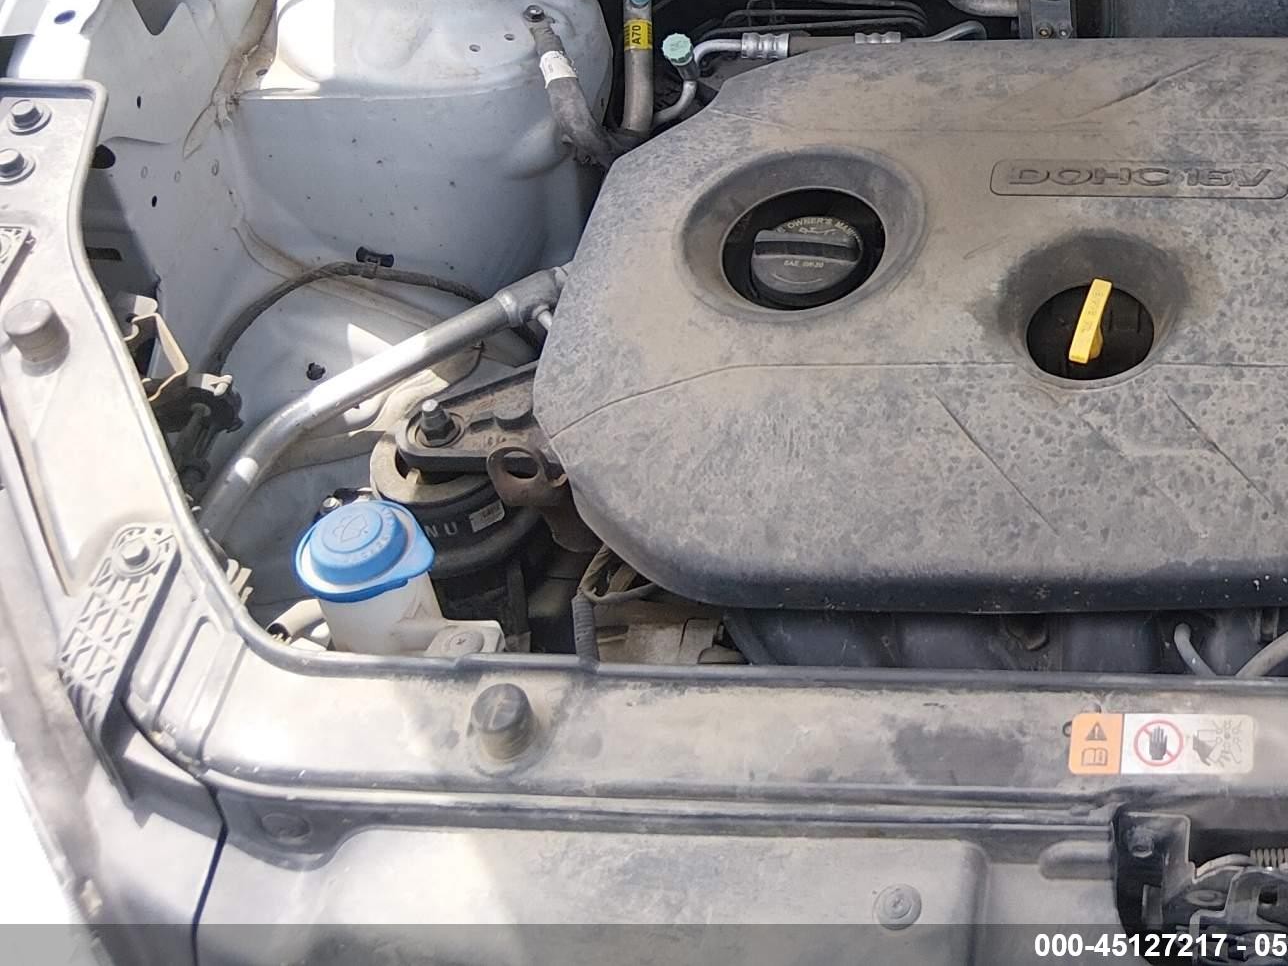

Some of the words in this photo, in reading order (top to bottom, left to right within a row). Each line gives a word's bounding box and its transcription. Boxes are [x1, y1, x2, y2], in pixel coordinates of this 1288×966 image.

[632, 25, 641, 44] A70
[1009, 167, 1170, 185] DOHC
[1182, 168, 1272, 186] 16V
[787, 217, 833, 229] OWNER'S
